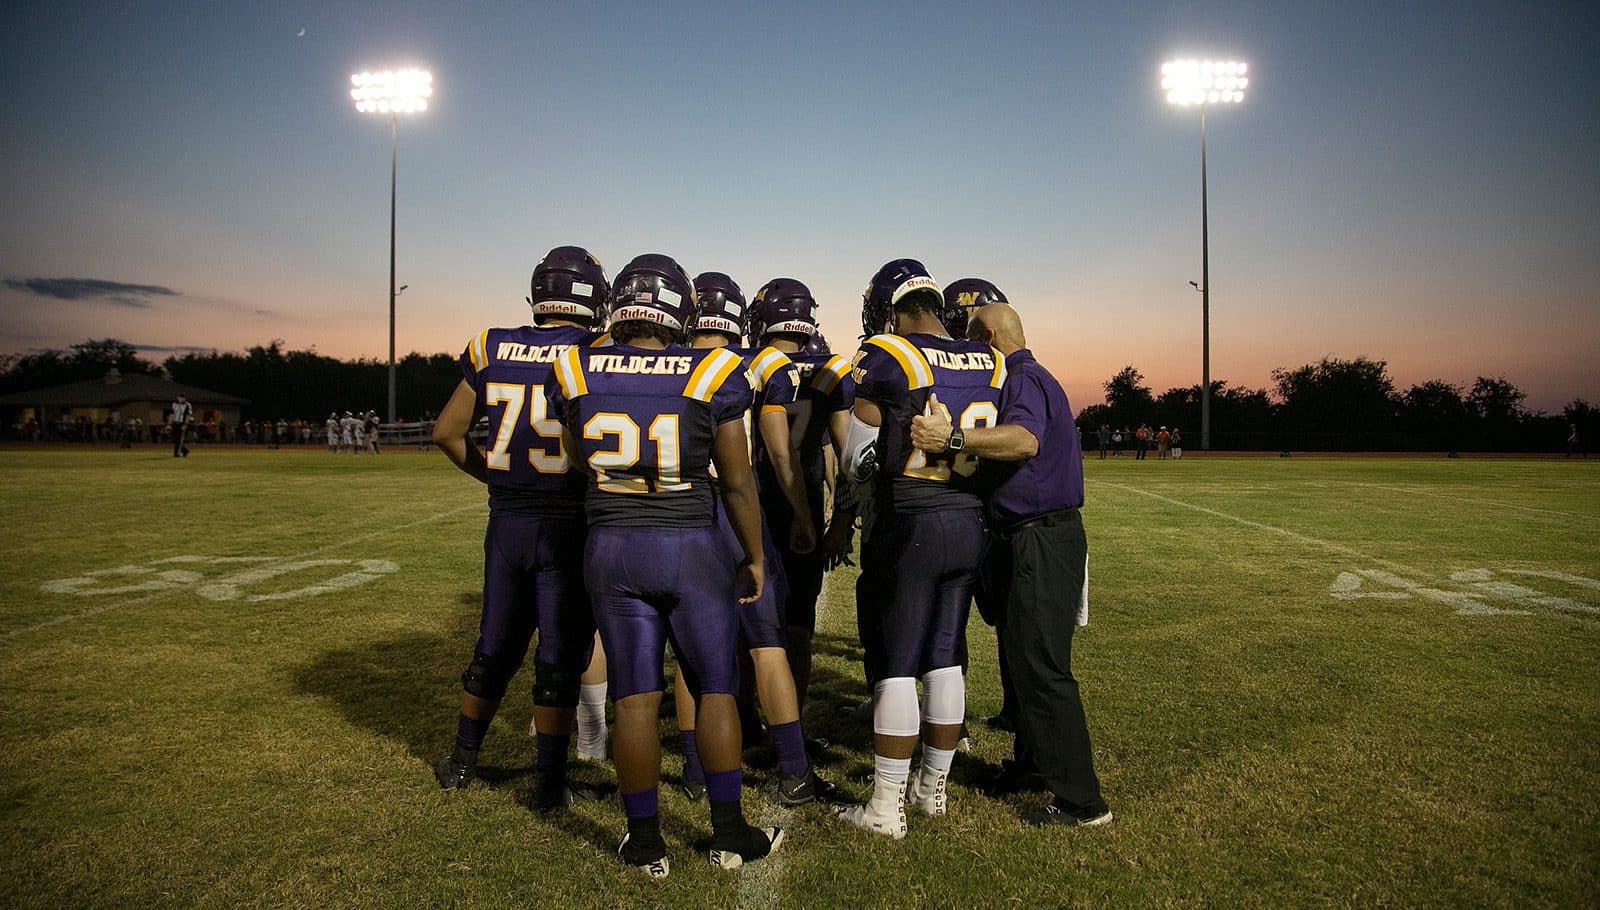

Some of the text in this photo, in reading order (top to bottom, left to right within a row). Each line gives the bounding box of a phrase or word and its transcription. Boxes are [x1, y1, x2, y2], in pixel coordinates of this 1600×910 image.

[539, 304, 577, 313] Riddell
[620, 308, 665, 324] Riddell
[695, 319, 730, 330] iddell
[496, 342, 578, 363] WILDCAT
[920, 347, 995, 370] WILDCATS
[588, 354, 693, 375] WILDCATS
[485, 382, 570, 474] 75
[583, 412, 693, 493] 21
[898, 787, 907, 833] UNDER
